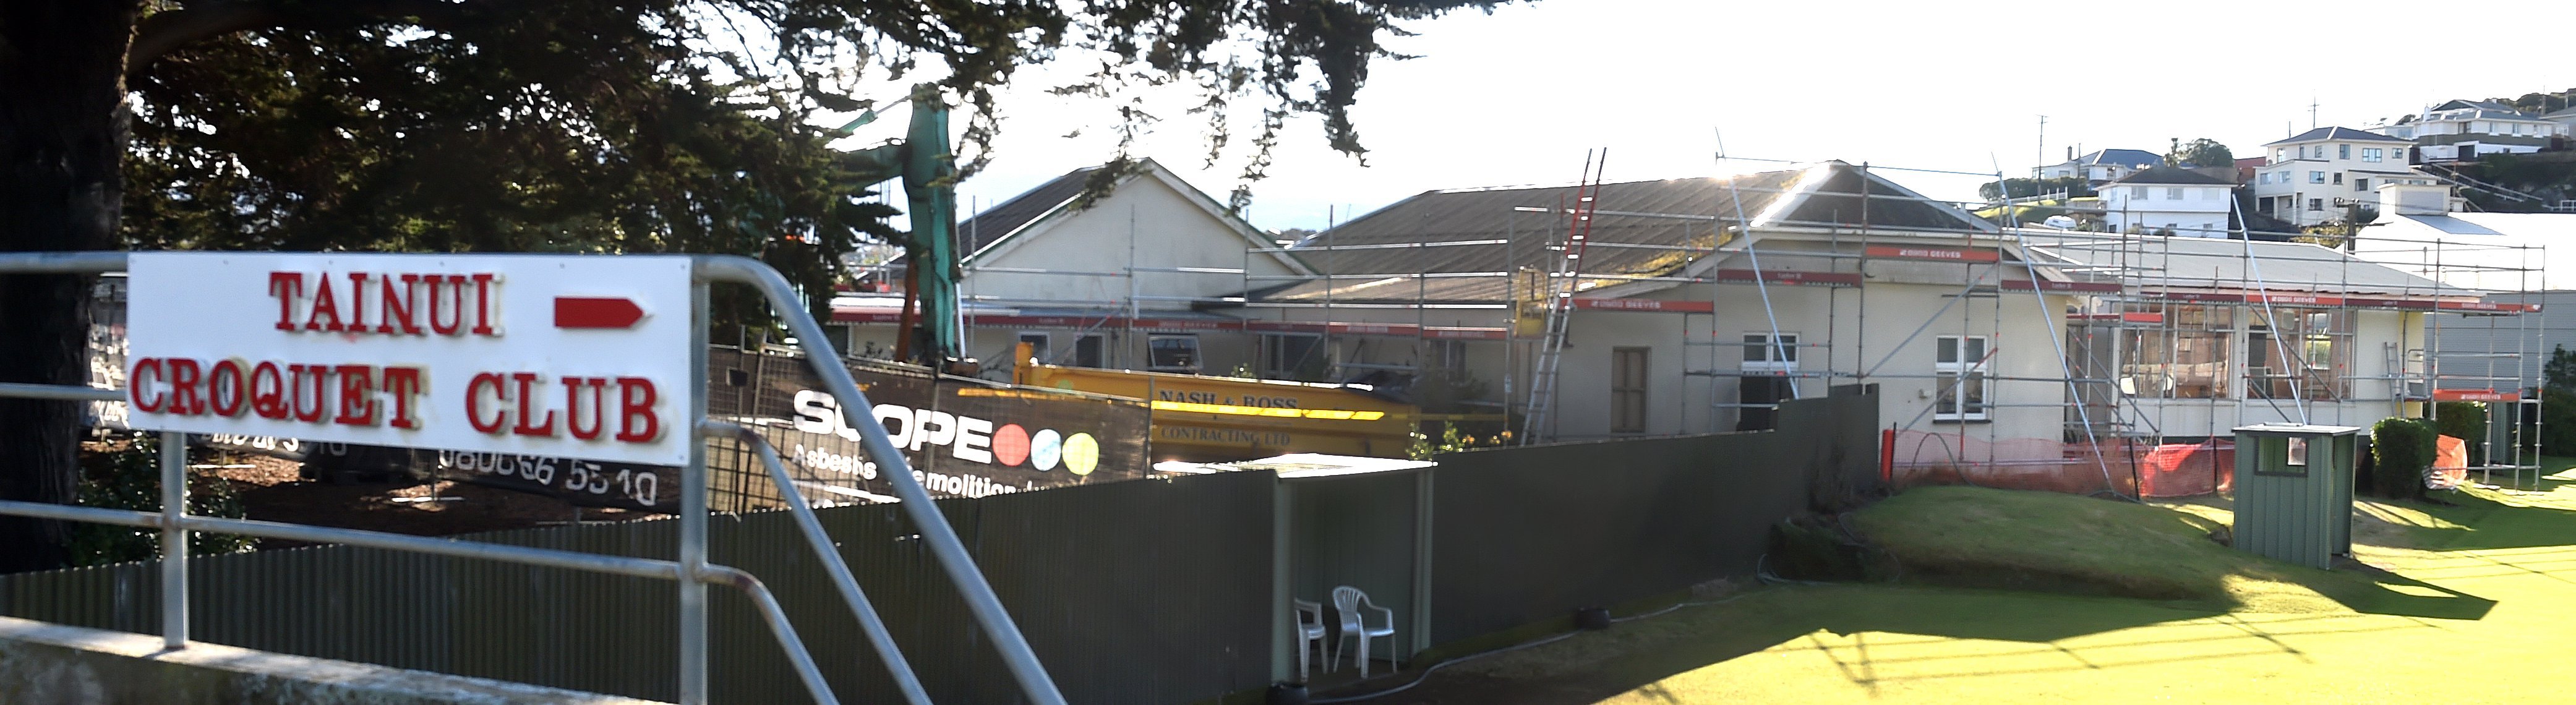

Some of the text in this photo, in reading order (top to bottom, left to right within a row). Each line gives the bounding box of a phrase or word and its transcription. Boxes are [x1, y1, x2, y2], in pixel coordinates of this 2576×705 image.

[268, 271, 495, 336] TAINUI
[131, 356, 421, 429] CROQUET
[465, 372, 659, 443] CLUB
[1159, 390, 1217, 404] NASH
[1161, 425, 1291, 446] CONTRACTING LTD
